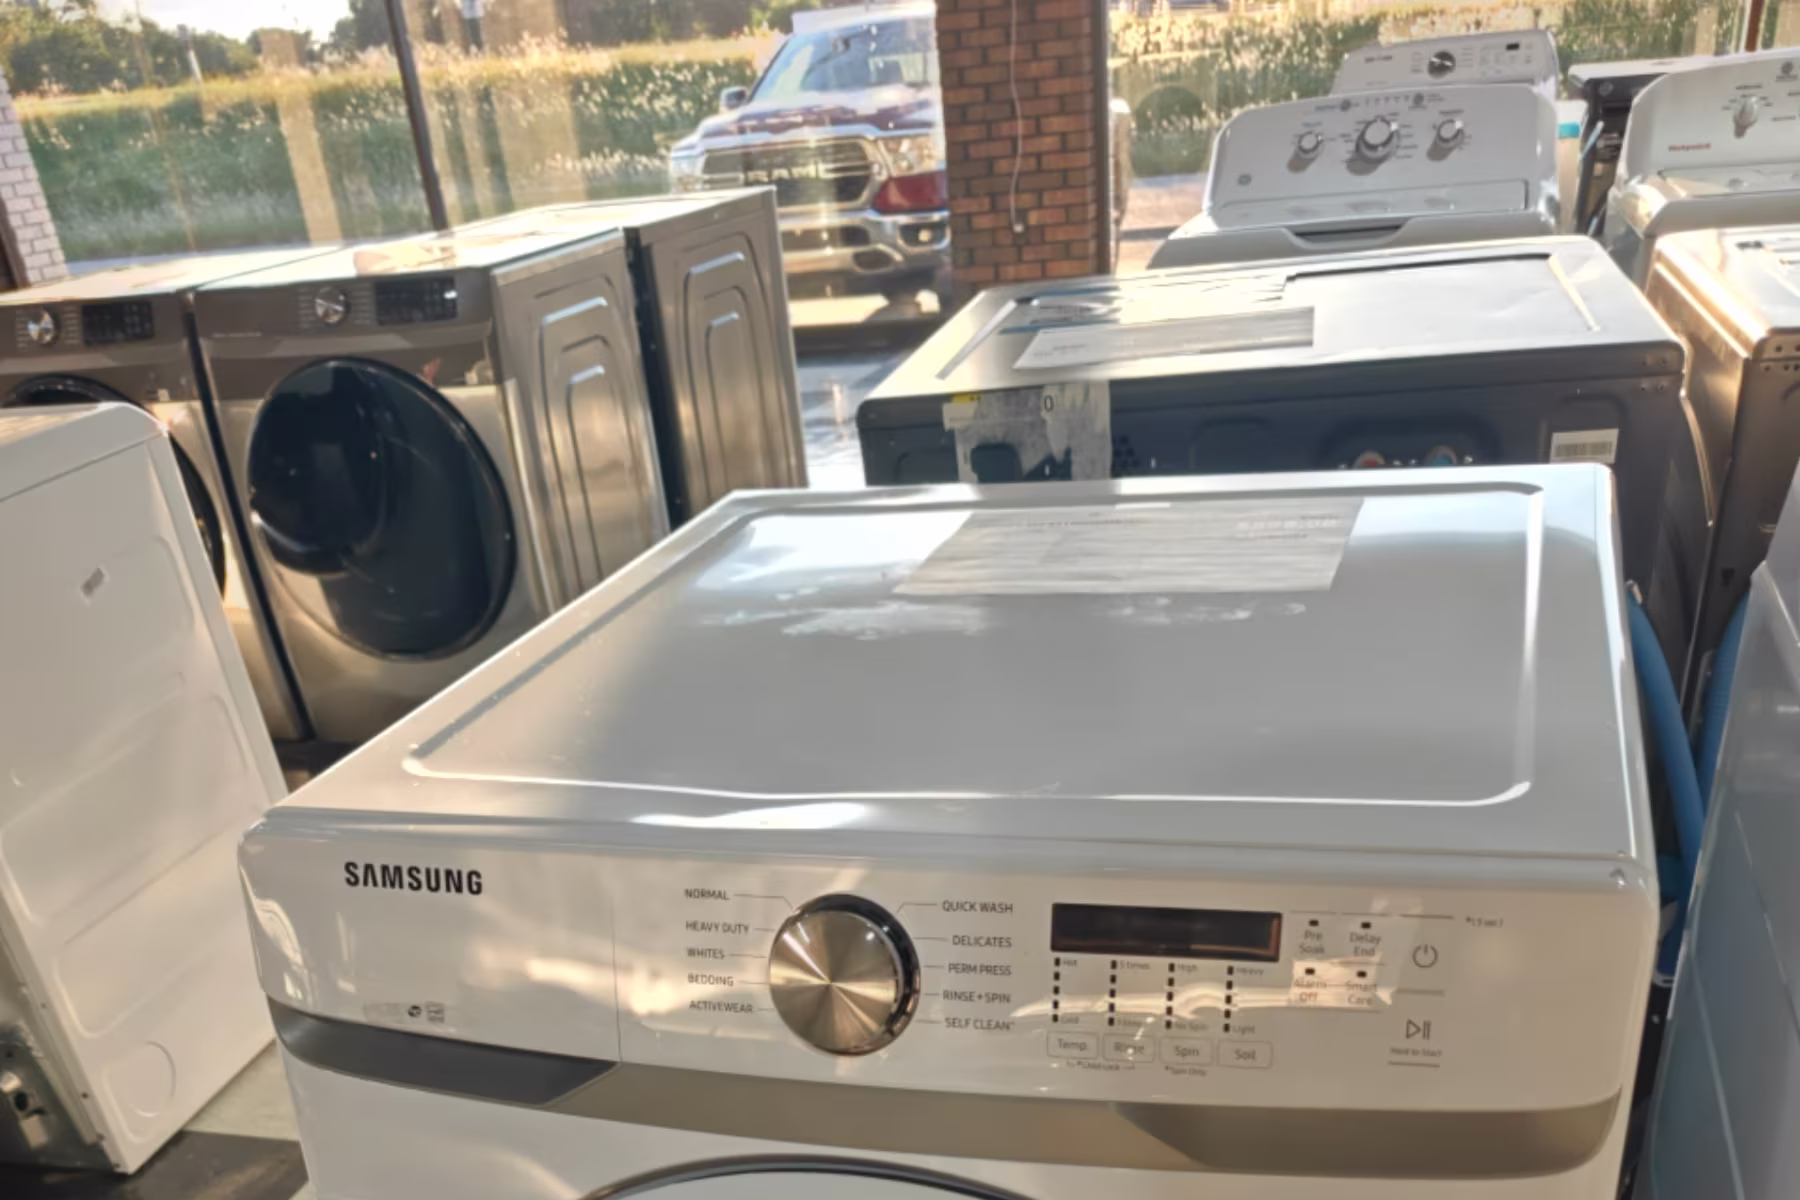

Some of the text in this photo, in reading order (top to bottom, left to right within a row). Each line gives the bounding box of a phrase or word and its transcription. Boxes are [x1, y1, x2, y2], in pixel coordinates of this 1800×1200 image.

[344, 861, 483, 896] SAMSUNG
[684, 888, 729, 900] NORMAL
[942, 899, 1013, 914] QUICK WASH
[685, 920, 750, 935] HEAVY DUTY
[952, 935, 1012, 948] DELICATES
[1304, 930, 1323, 940] Pre
[1349, 931, 1381, 945] Delay
[686, 947, 725, 960] WHITES
[1299, 942, 1325, 955] Soak
[1353, 945, 1376, 957] End
[948, 963, 1012, 976] PERM PRESS
[687, 973, 734, 987] BEDDING
[1294, 977, 1328, 990] Alarm
[1344, 980, 1377, 992] Smart
[1298, 992, 1319, 1003] Off
[1347, 994, 1374, 1006] Care
[689, 1000, 753, 1014] ACTIVEWEAR
[944, 1017, 971, 1029] SELF
[1174, 1044, 1200, 1058] Spin
[1234, 1048, 1257, 1061] Soil
